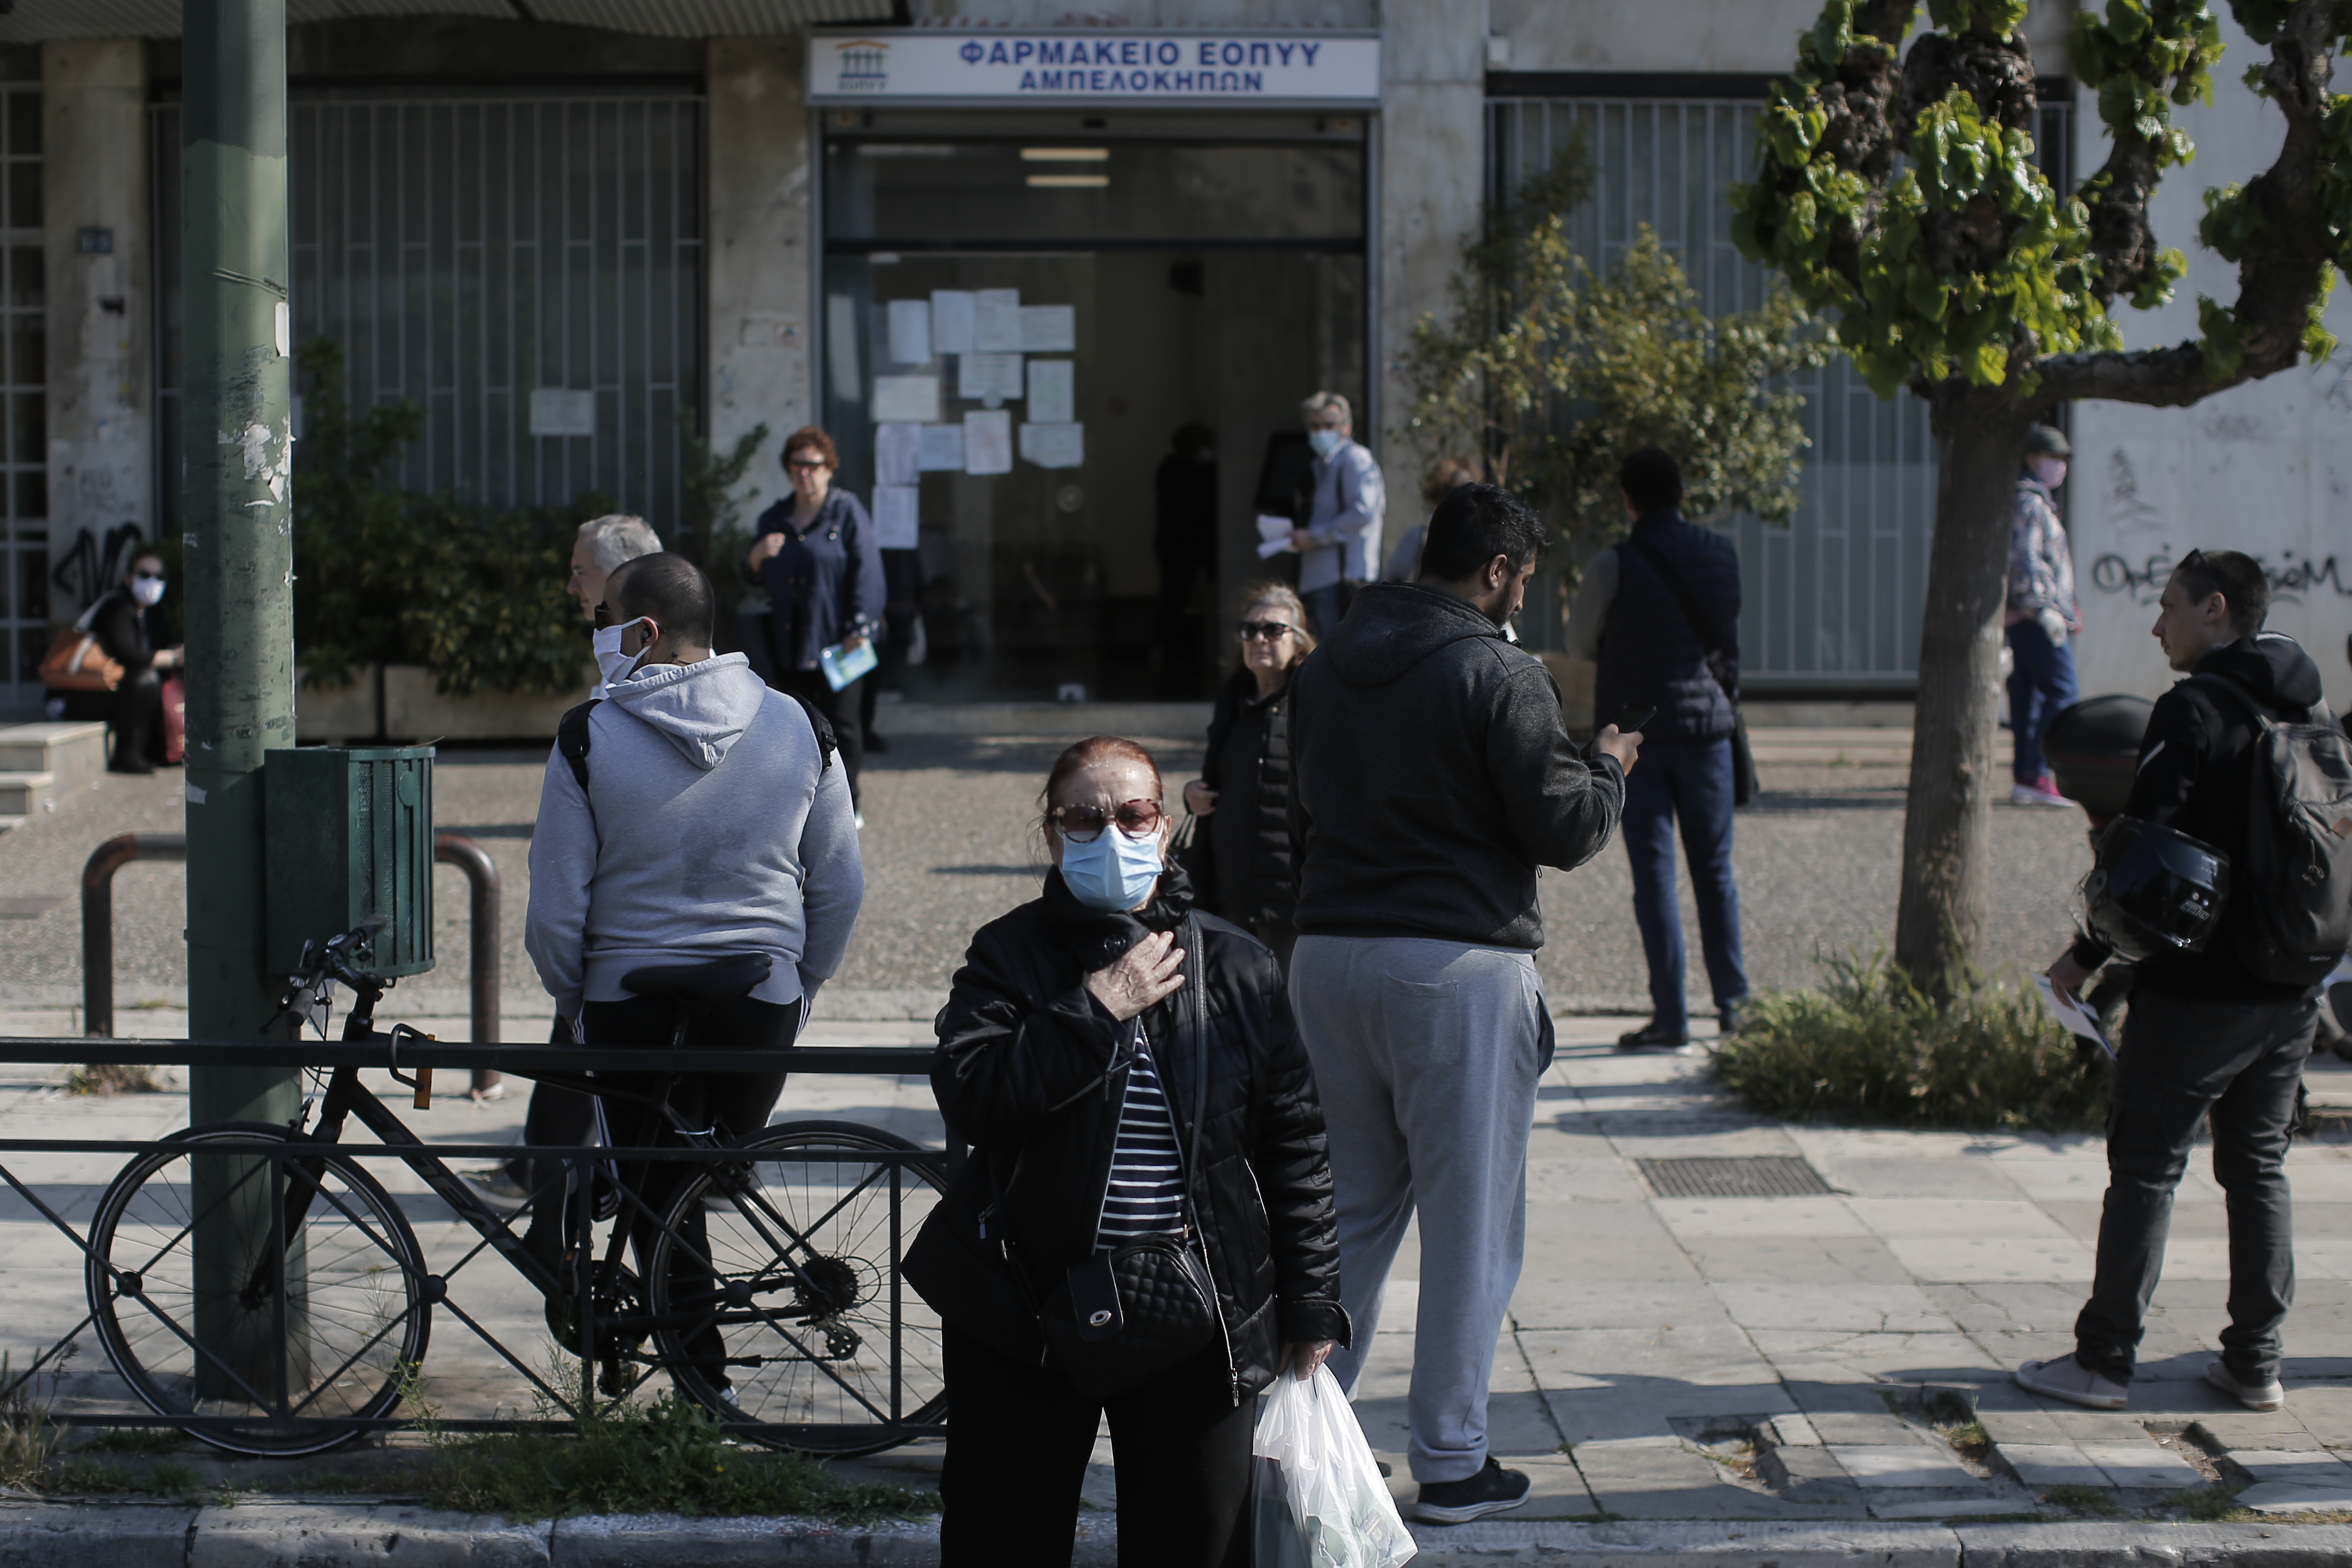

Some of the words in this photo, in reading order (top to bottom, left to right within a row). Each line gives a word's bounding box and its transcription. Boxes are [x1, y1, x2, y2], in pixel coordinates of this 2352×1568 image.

[960, 40, 1180, 65] ΦΑΡΜΑΚΕΙΟ
[1199, 42, 1320, 66] ΕΟΠΥΥ
[1019, 70, 1262, 91] ΑΜΠΕΛΟΚΗΠΩΝ
